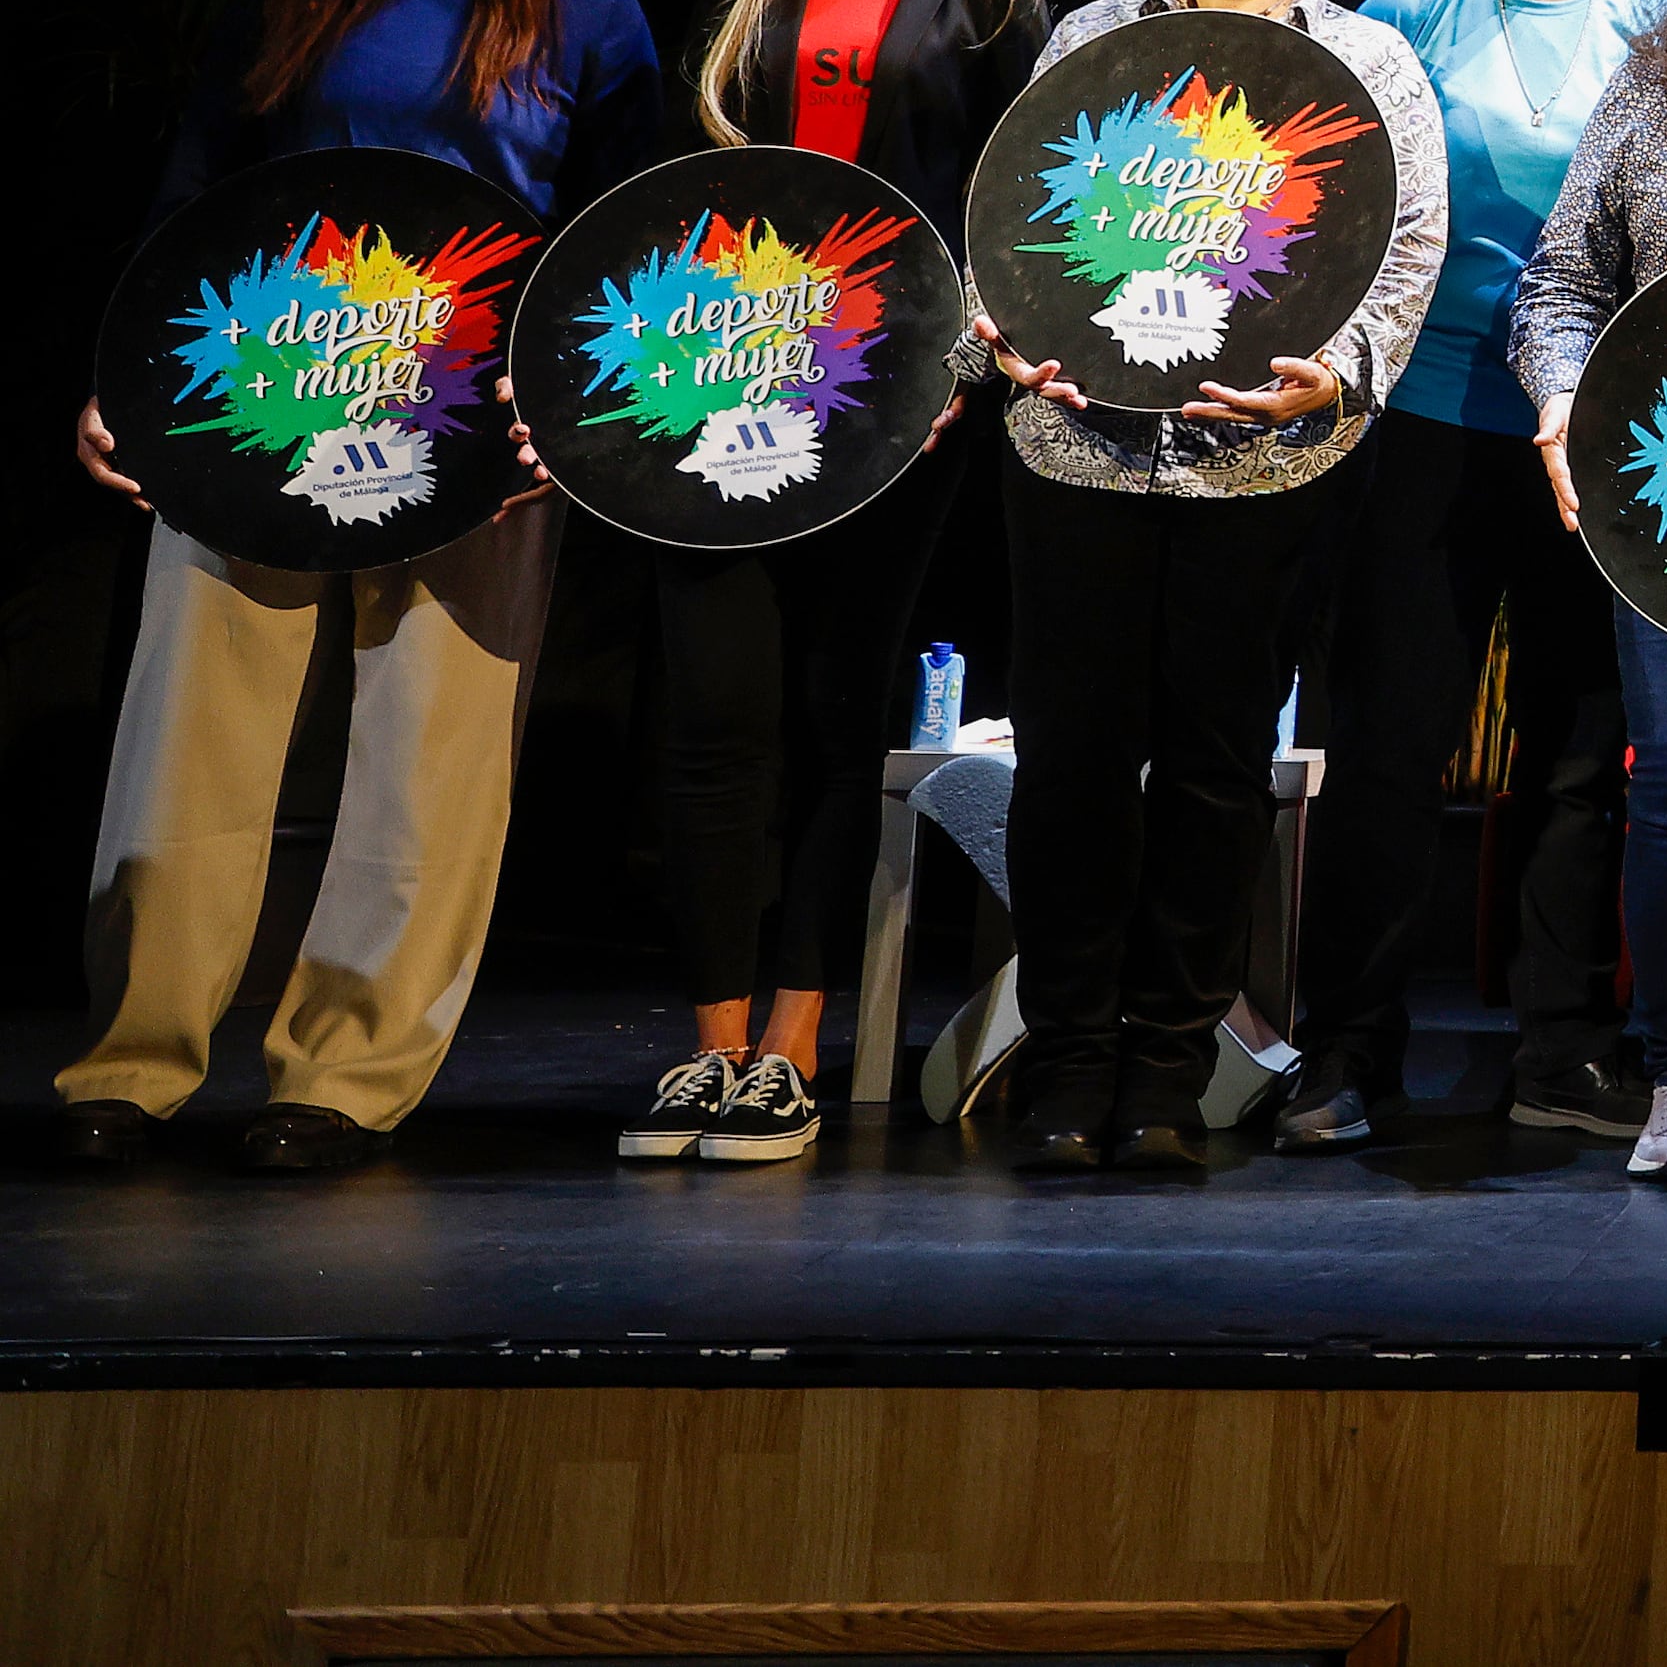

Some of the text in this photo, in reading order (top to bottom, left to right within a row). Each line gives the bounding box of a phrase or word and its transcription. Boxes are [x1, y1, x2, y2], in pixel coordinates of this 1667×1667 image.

[1118, 144, 1288, 211] deporte
[1128, 204, 1249, 271] mujer
[266, 286, 456, 365] deporte
[665, 272, 842, 351] deporte
[293, 348, 435, 423] mujer
[694, 333, 827, 406] mujer
